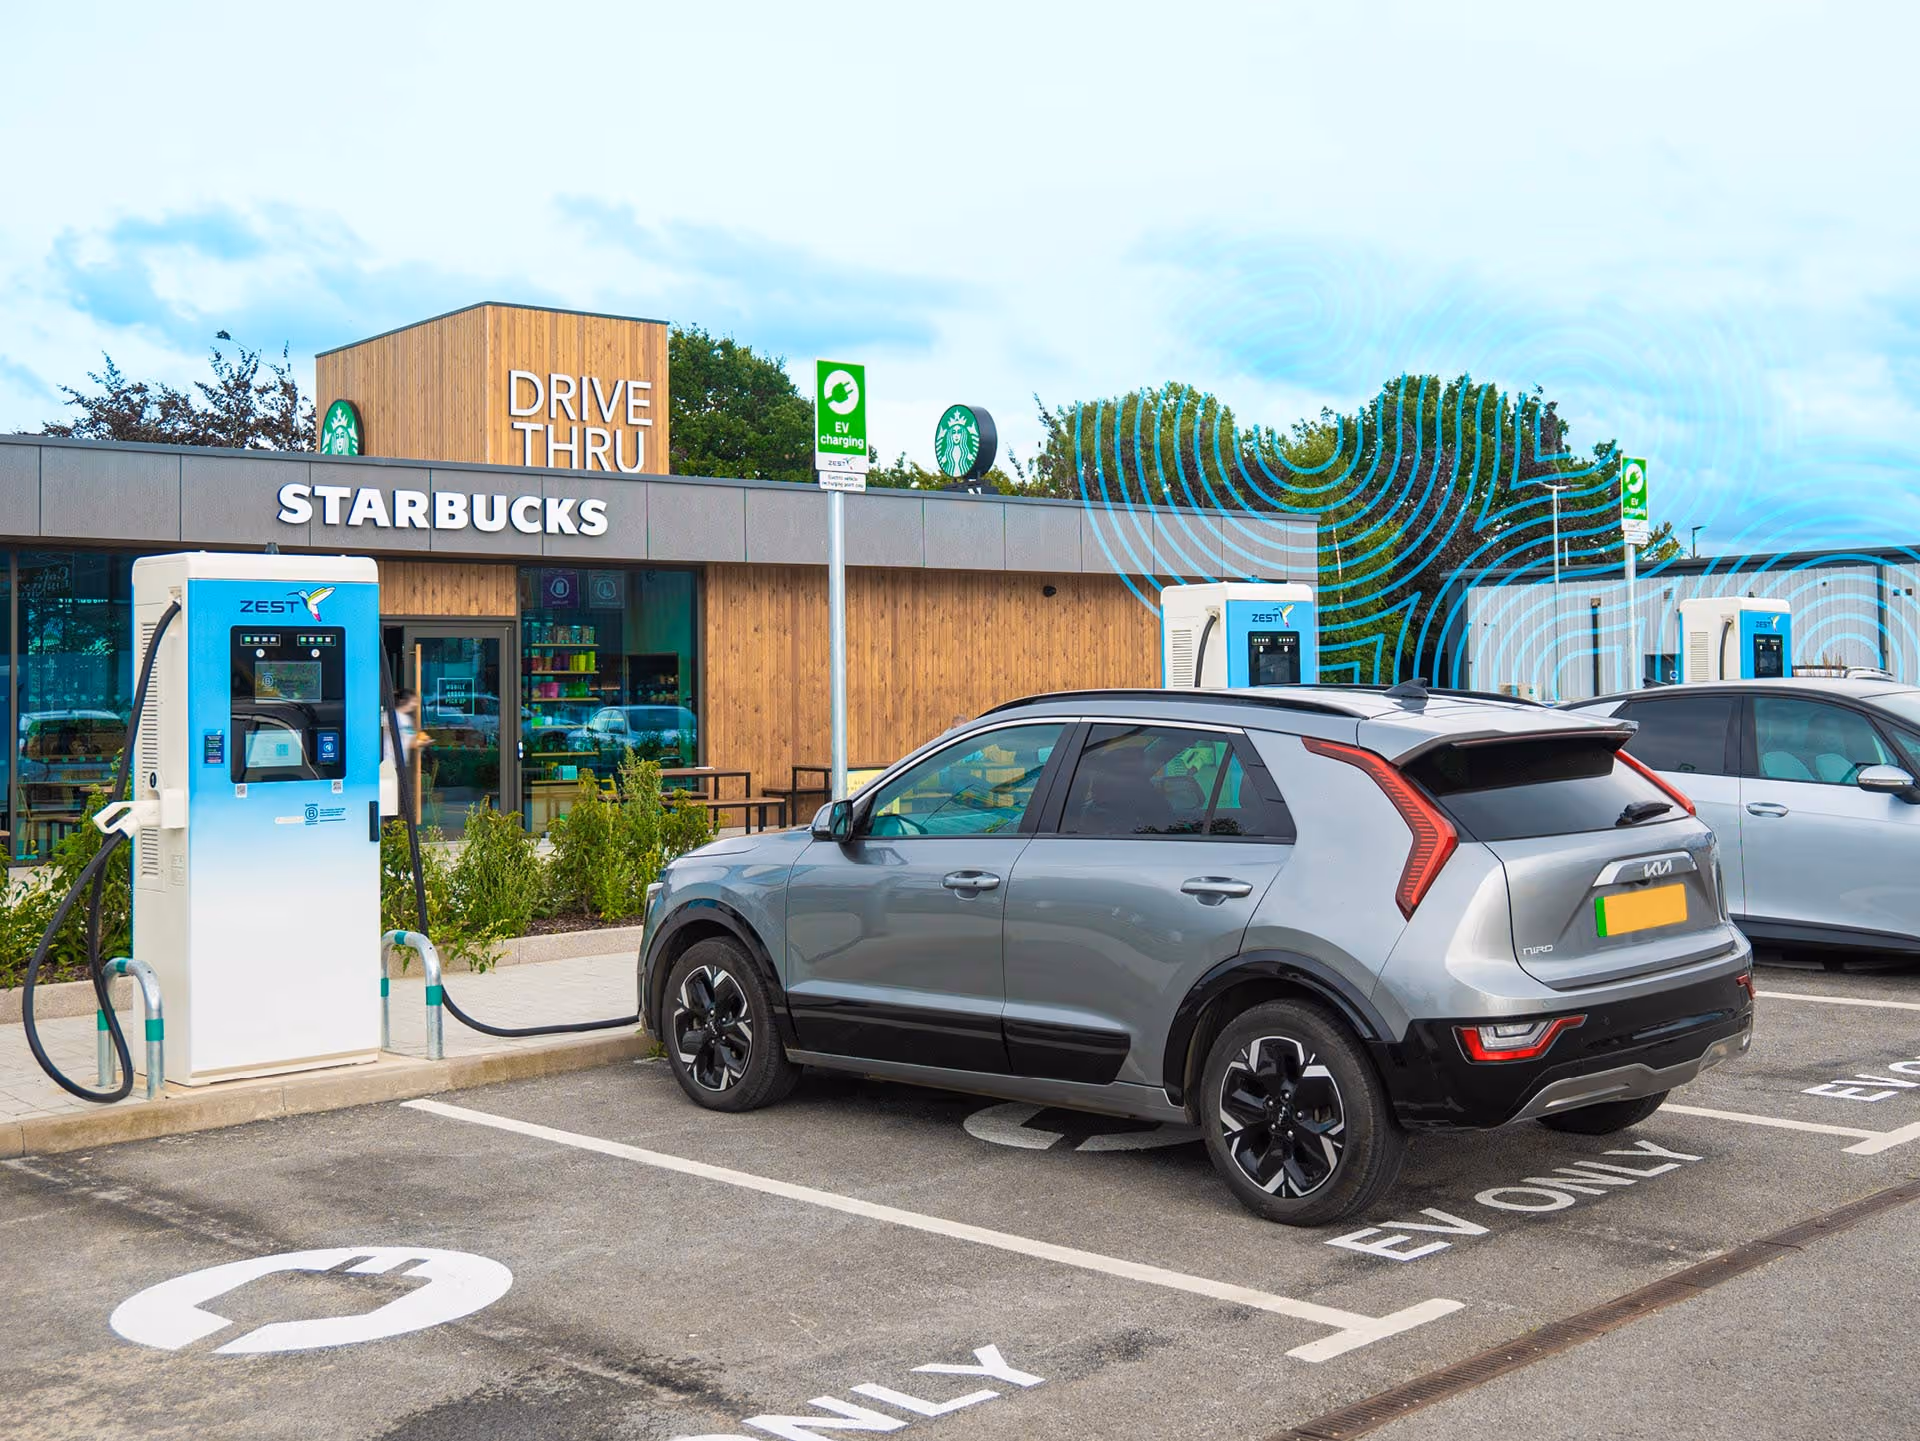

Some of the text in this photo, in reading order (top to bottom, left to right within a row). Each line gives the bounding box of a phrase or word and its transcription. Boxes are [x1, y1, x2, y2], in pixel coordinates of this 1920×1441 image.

[509, 370, 653, 426] DRIVE
[512, 421, 645, 474] THRU
[820, 434, 864, 449] charging
[835, 421, 849, 433] EV
[277, 482, 609, 537] STARBUCKS
[240, 600, 300, 614] ZEST
[1252, 613, 1279, 623] ZEST
[1800, 1073, 1920, 1103] EV
[1323, 1140, 1704, 1263] EV ONLY
[672, 1343, 1047, 1441] NLY
